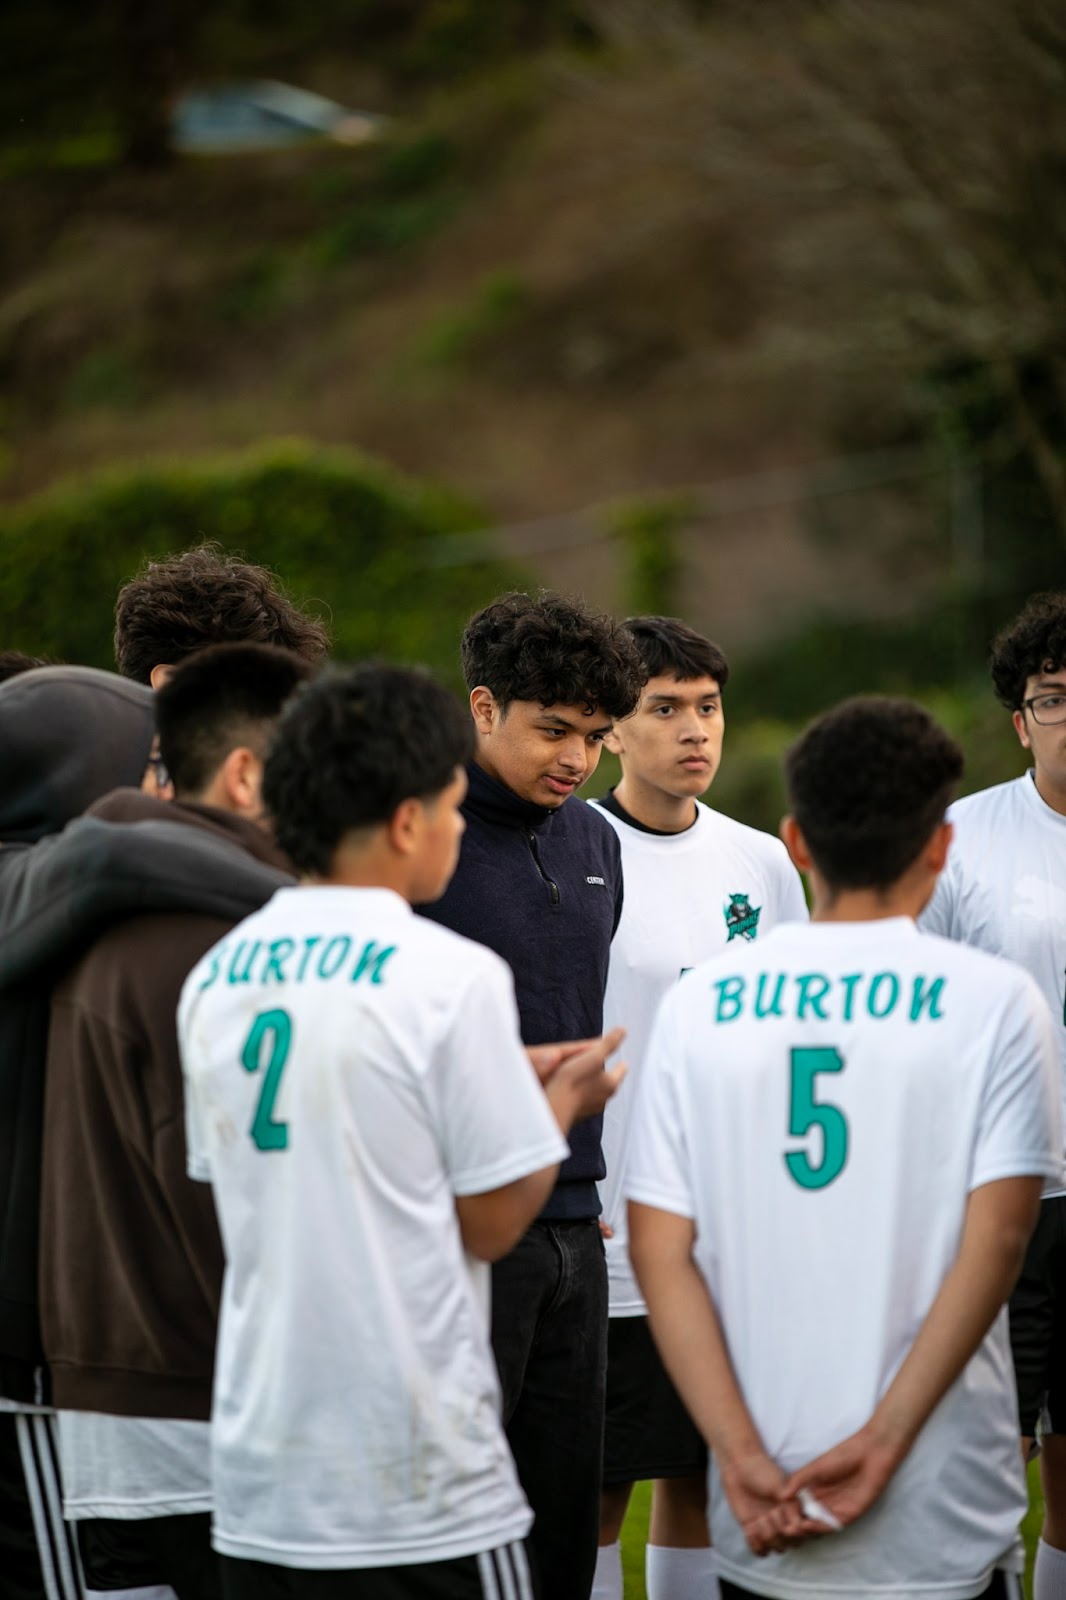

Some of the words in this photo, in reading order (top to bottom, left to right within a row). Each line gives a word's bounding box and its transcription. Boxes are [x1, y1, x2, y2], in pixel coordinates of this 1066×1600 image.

[712, 971, 947, 1024] BURTON
[240, 1007, 293, 1152] 2
[783, 1044, 850, 1191] 5
